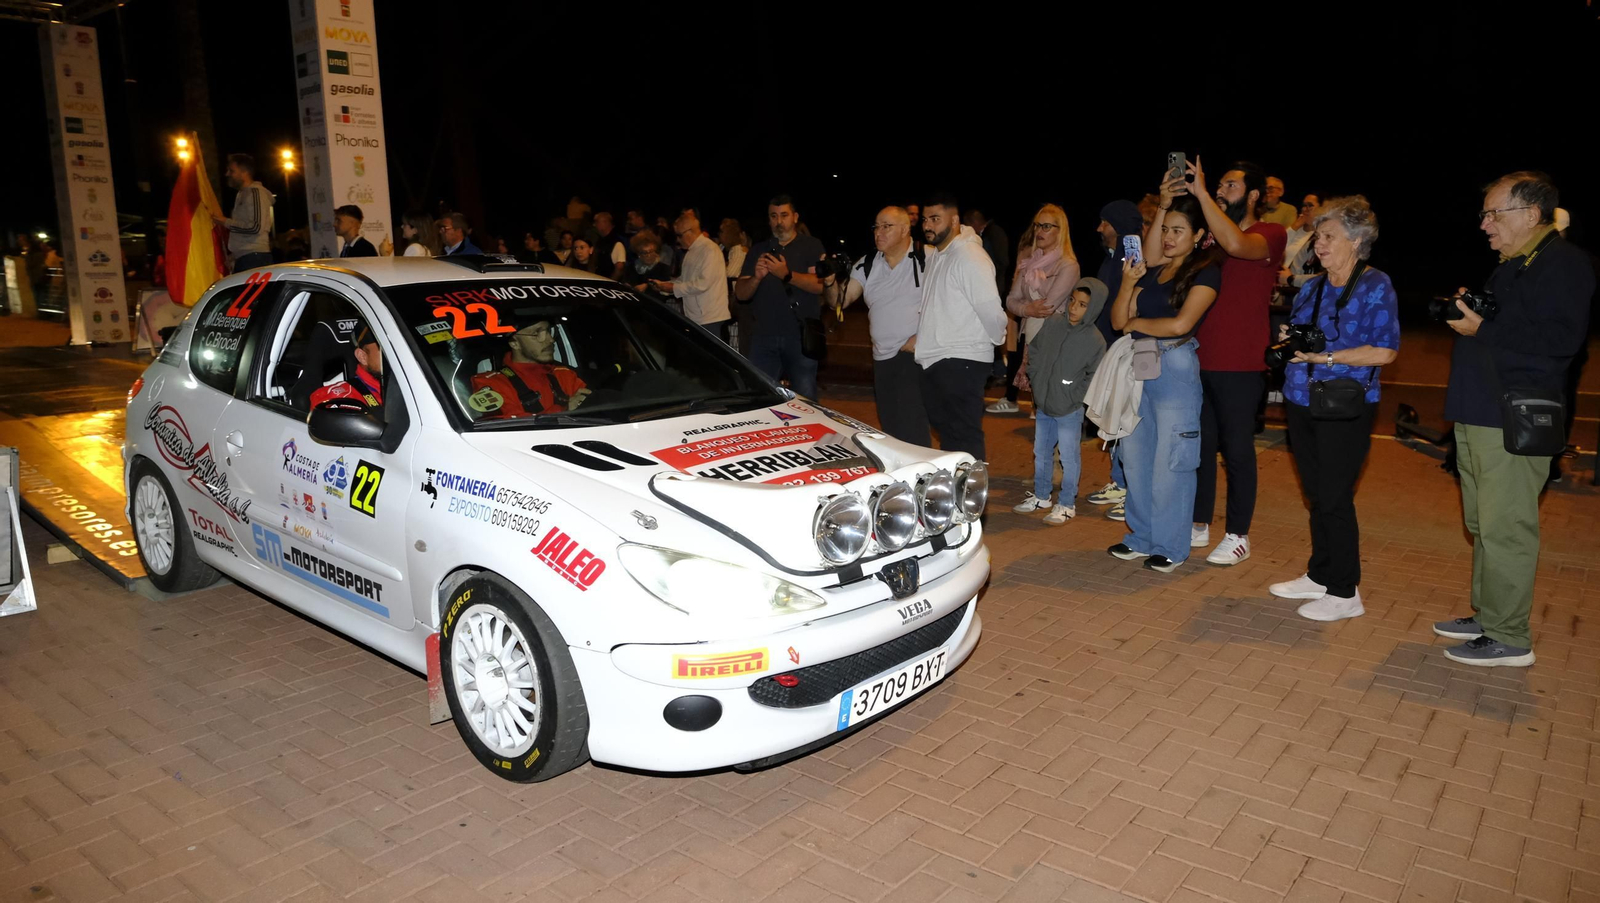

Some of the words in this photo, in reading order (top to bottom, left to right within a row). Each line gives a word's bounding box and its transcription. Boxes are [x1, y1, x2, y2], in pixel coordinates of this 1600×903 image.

[330, 84, 375, 96] gasolia
[335, 133, 379, 148] Phonika
[226, 271, 273, 319] 22
[432, 302, 517, 340] 22
[677, 434, 752, 455] BLANQUEO
[760, 426, 808, 439] LAVADO
[698, 449, 722, 460] DE
[718, 433, 815, 455] INVERNADEROS
[288, 463, 318, 485] ALMERÍA
[295, 454, 313, 468] COSTA
[312, 461, 321, 471] DE
[697, 443, 859, 482] HERRIBLAN
[809, 470, 843, 484] 139
[839, 465, 871, 477] 767
[352, 465, 381, 515] 22
[436, 470, 497, 501] FONTANERÍA
[496, 487, 553, 516] 657542645
[189, 508, 234, 542] TOTAL
[448, 496, 491, 523] EXPOSITO
[491, 508, 540, 537] 609159292
[530, 526, 606, 588] JALEO
[677, 651, 763, 677] PIRELLI
[842, 713, 848, 723] E
[856, 671, 908, 717] 3709
[911, 651, 946, 691] BXT
